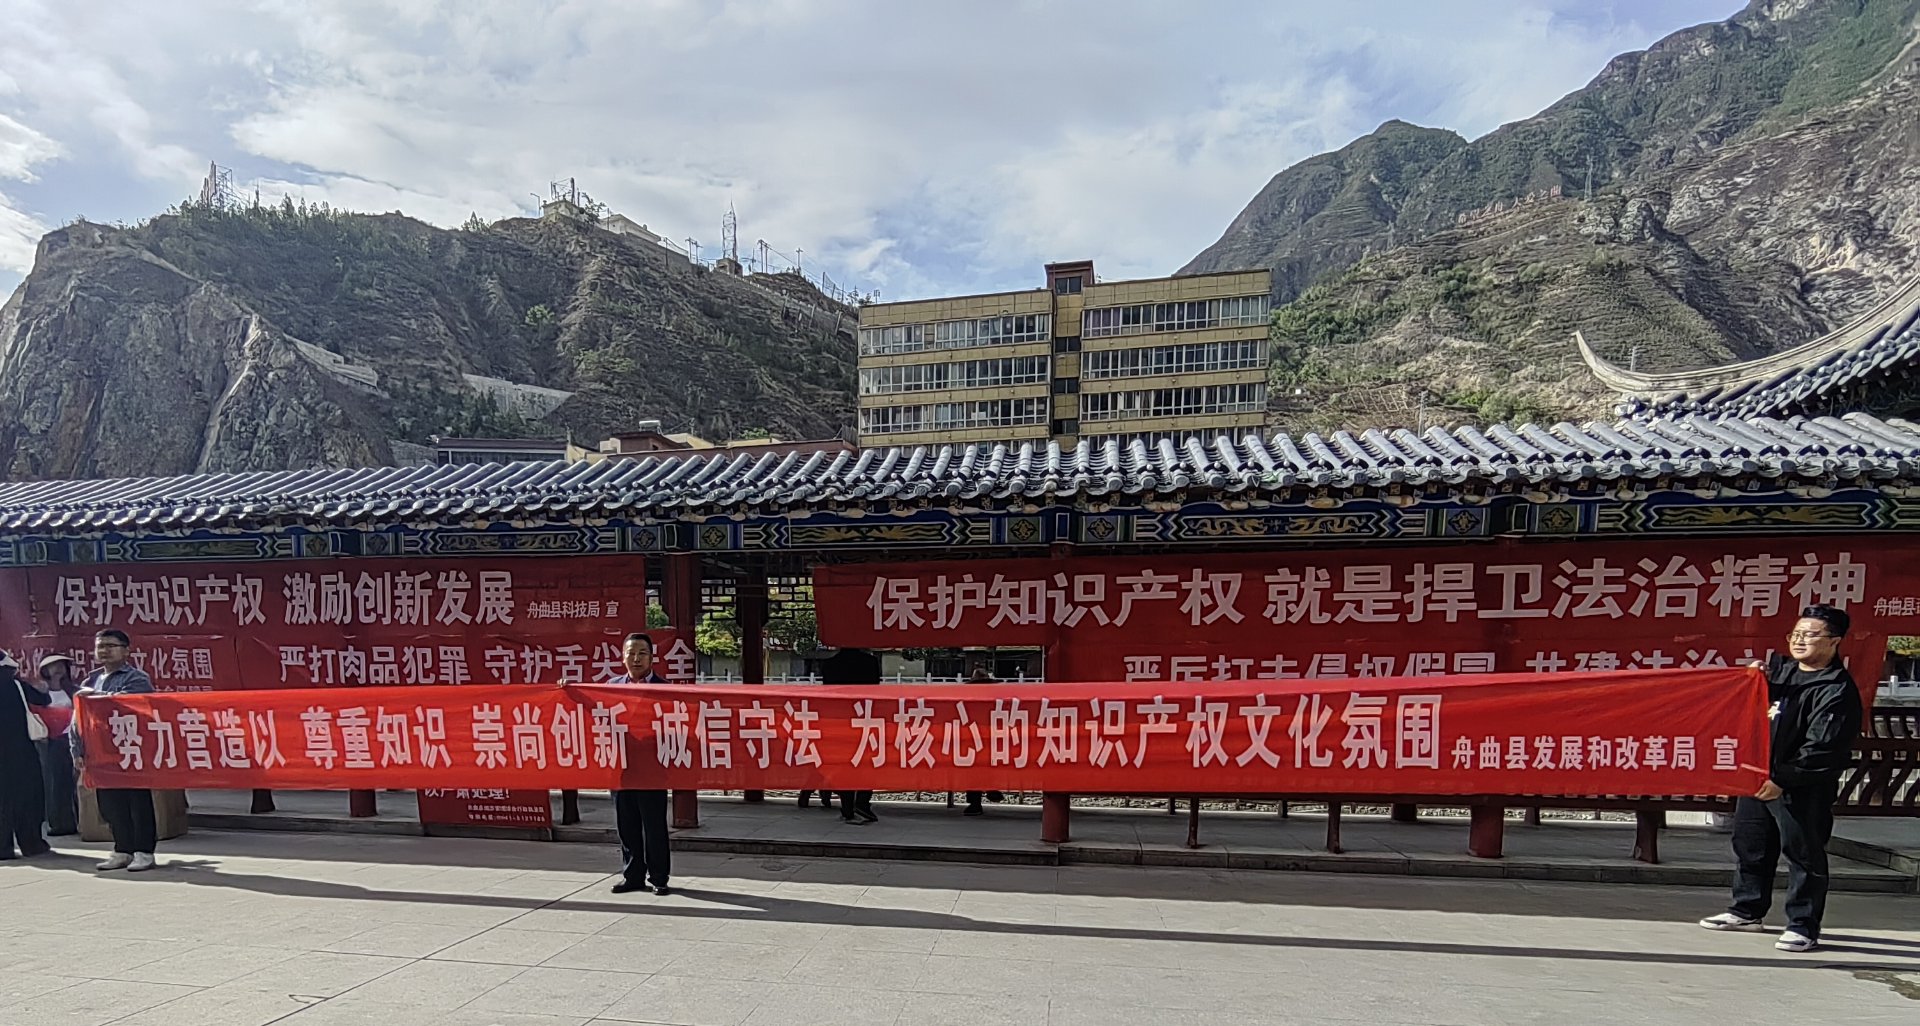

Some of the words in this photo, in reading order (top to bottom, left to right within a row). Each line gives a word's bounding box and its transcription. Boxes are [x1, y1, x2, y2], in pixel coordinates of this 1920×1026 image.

[55, 573, 266, 626] 保护知识产权
[283, 570, 515, 626] 激励创新发展
[527, 601, 600, 619] 舟曲县科技局
[605, 601, 619, 618] 宣
[866, 568, 1244, 631] 保护知识产权
[1262, 552, 1867, 623] 就是捍卫法治精神
[278, 645, 472, 685] 严打肉品犯罪
[484, 639, 695, 685] 守护舌尖全
[108, 708, 286, 770] 努力营造以
[301, 706, 451, 770] 尊重知识
[471, 701, 628, 770] 崇尚创新
[651, 699, 822, 769] 诚信守法
[850, 692, 1442, 770] 为核心的知识产权文化氛围
[1451, 735, 1696, 771] 舟曲县发展和改革局
[1712, 735, 1738, 771] 宣
